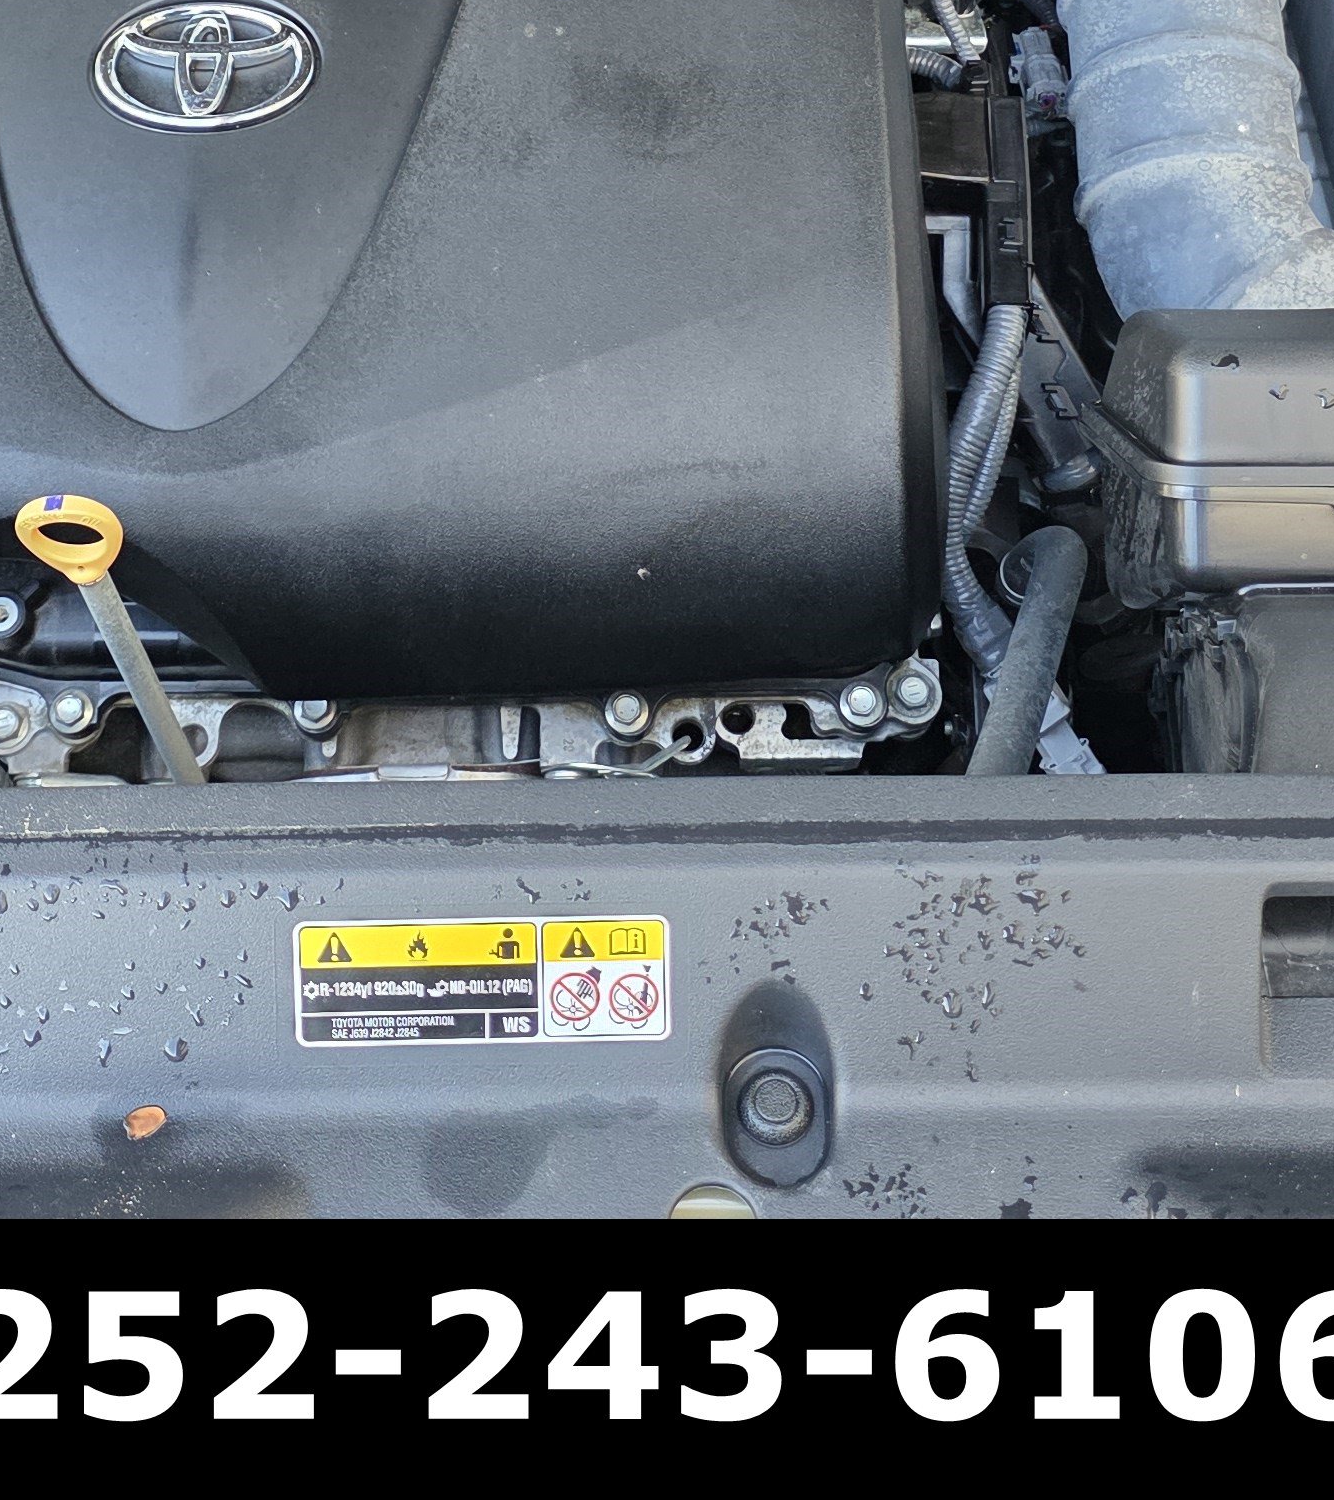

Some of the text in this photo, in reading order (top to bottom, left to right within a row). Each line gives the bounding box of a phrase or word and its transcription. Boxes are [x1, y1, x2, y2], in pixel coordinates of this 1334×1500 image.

[502, 979, 533, 995] (PAG)
[331, 1015, 455, 1028] TOYOTA MOTOR CORPORATION
[502, 1016, 531, 1033] WS
[331, 1029, 348, 1039] SAE
[349, 1028, 368, 1038] J639
